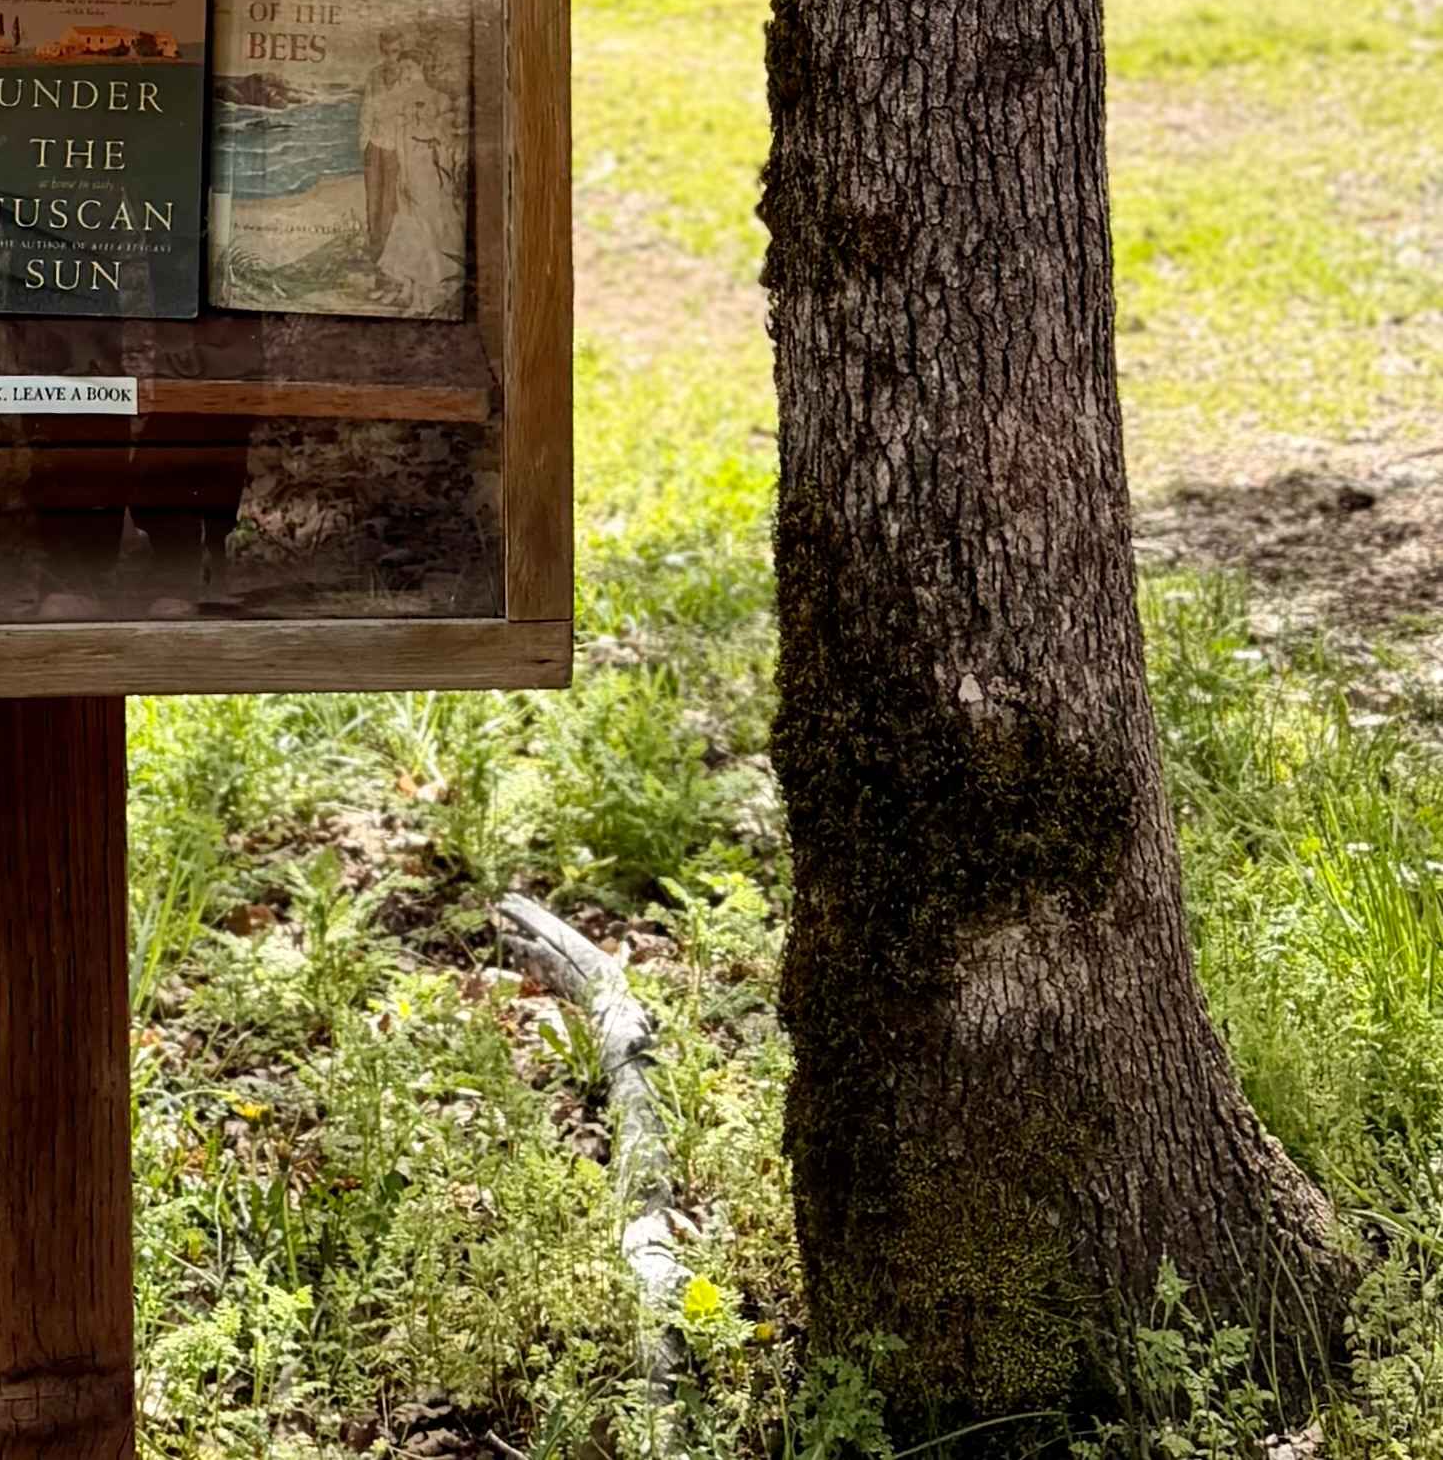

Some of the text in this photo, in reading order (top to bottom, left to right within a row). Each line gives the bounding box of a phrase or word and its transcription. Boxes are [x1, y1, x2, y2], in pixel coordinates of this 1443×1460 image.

[249, 2, 343, 26] OF THE
[247, 31, 327, 64] BEES
[29, 138, 125, 170] THE
[20, 239, 66, 250] AUTHOR
[25, 258, 123, 291] SUN
[13, 386, 67, 401] LEAVE
[71, 387, 82, 401] A
[86, 387, 133, 402] BOOK
